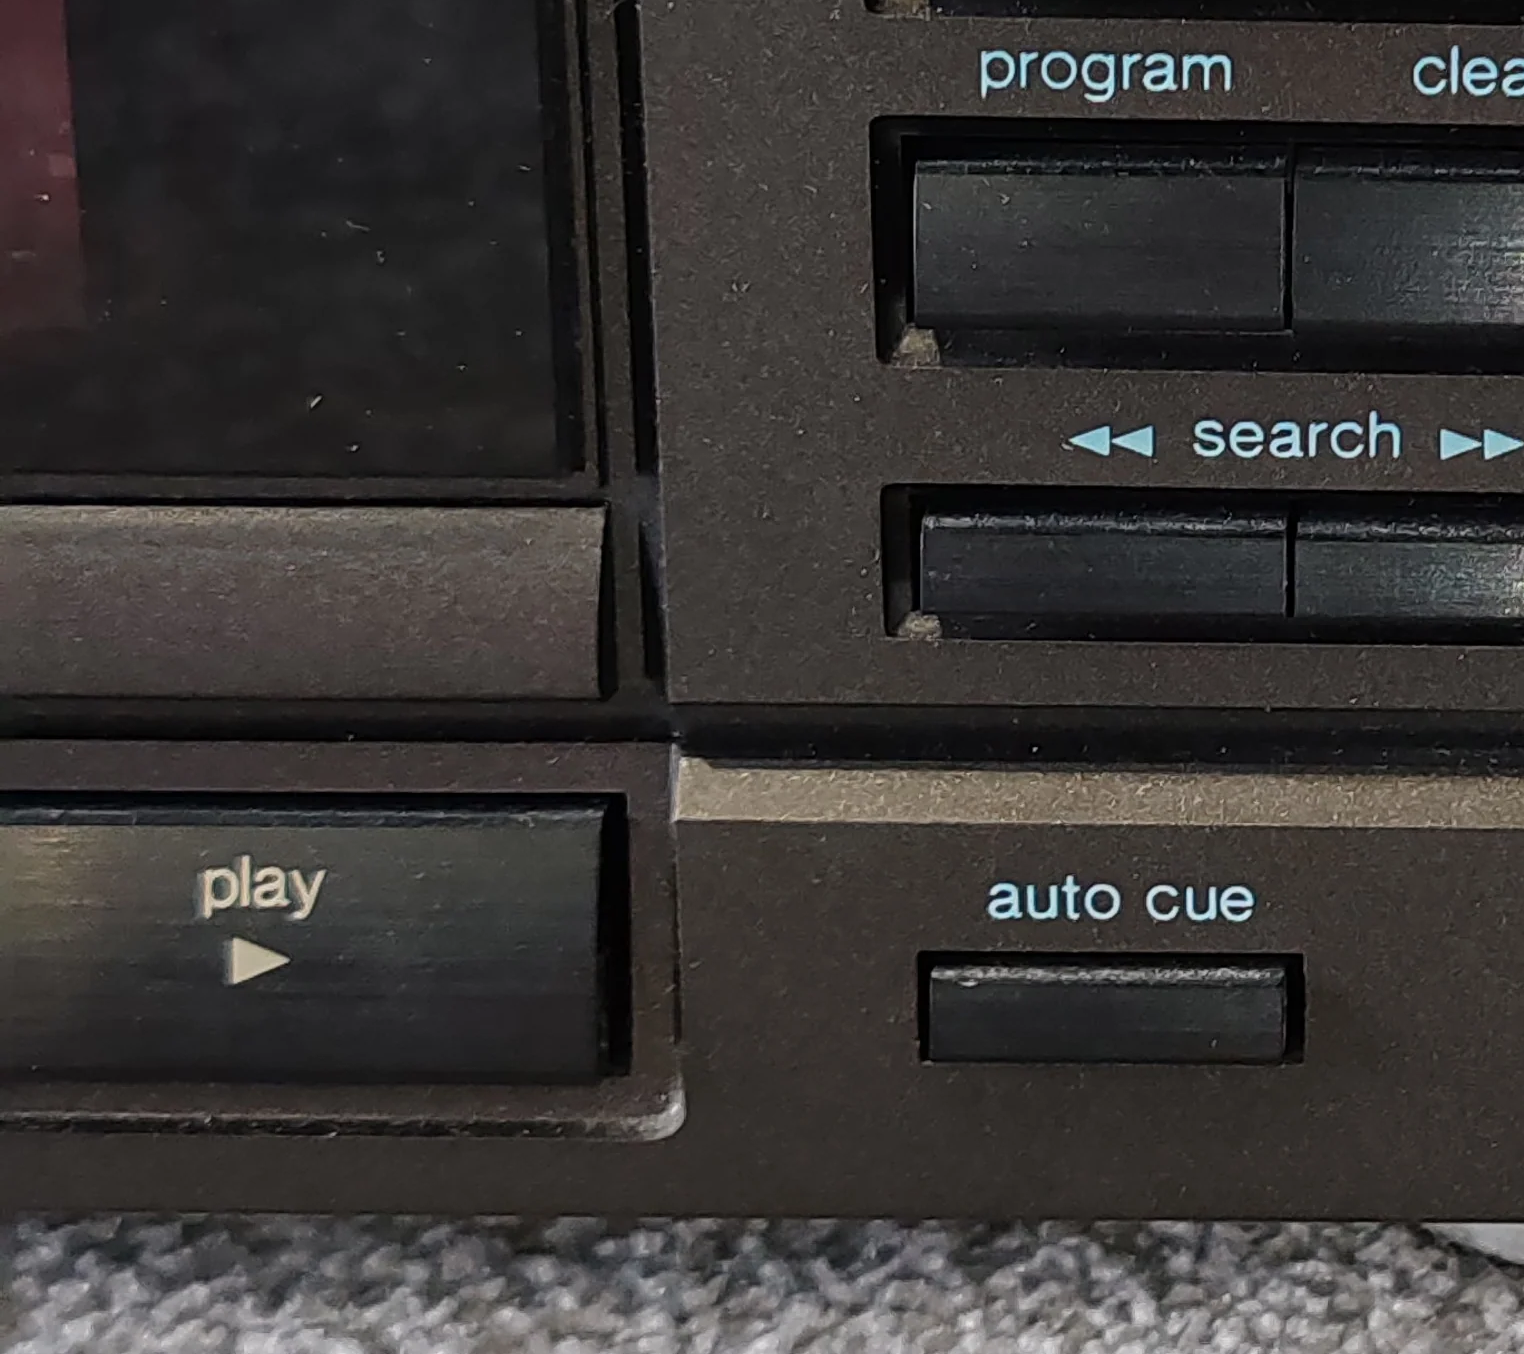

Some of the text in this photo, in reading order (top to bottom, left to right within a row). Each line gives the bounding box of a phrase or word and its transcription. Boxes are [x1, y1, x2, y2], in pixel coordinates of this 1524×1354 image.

[980, 50, 1232, 103] program
[1192, 410, 1401, 459] search
[201, 855, 326, 920] play
[987, 875, 1254, 922] auto cue
